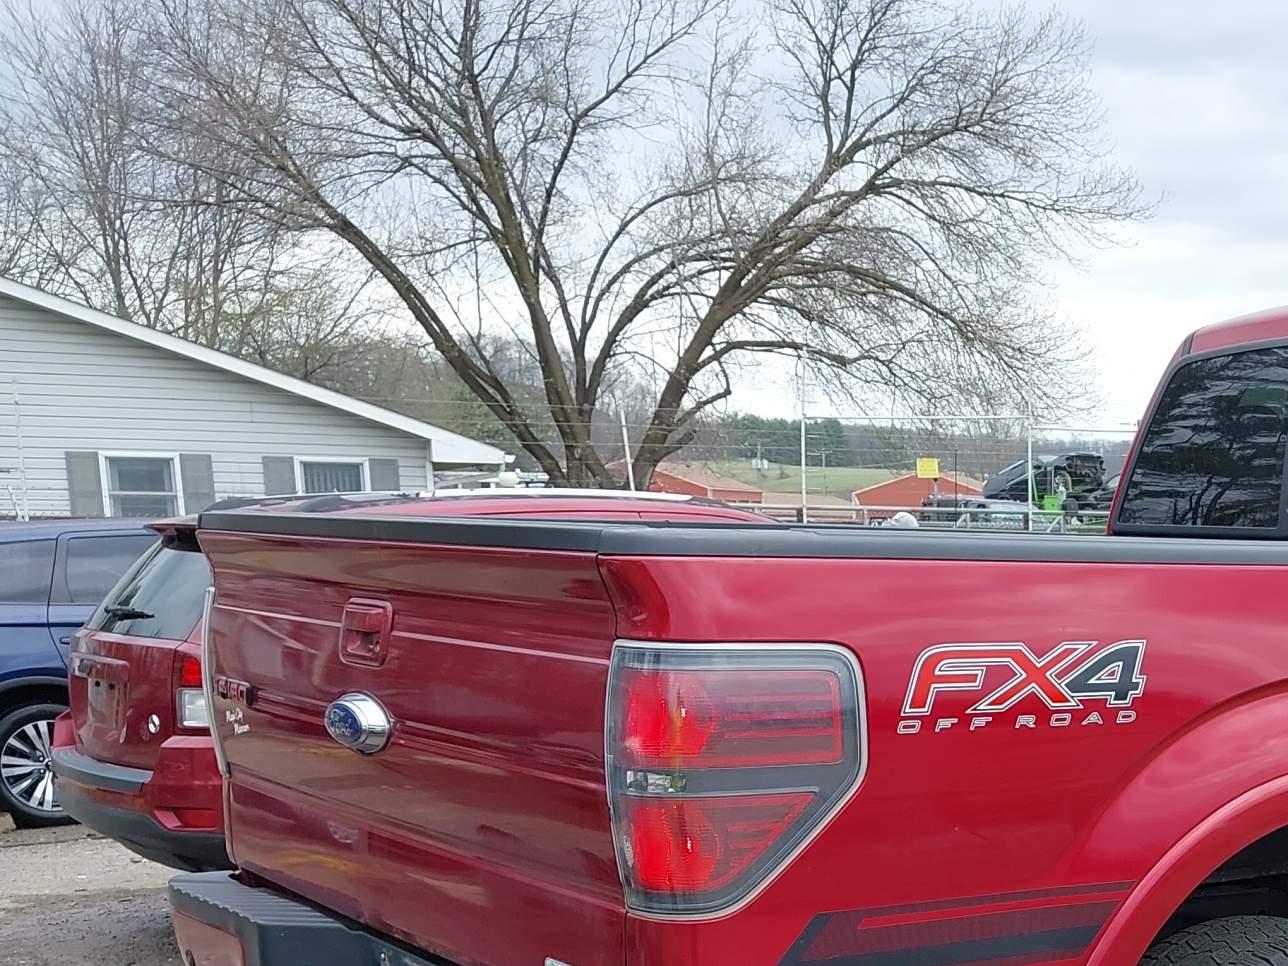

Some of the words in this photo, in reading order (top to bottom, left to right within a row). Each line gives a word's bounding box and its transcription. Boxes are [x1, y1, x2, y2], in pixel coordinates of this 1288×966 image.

[901, 640, 1147, 716] FX4
[897, 717, 993, 734] OFF
[1015, 710, 1137, 729] ROAD
